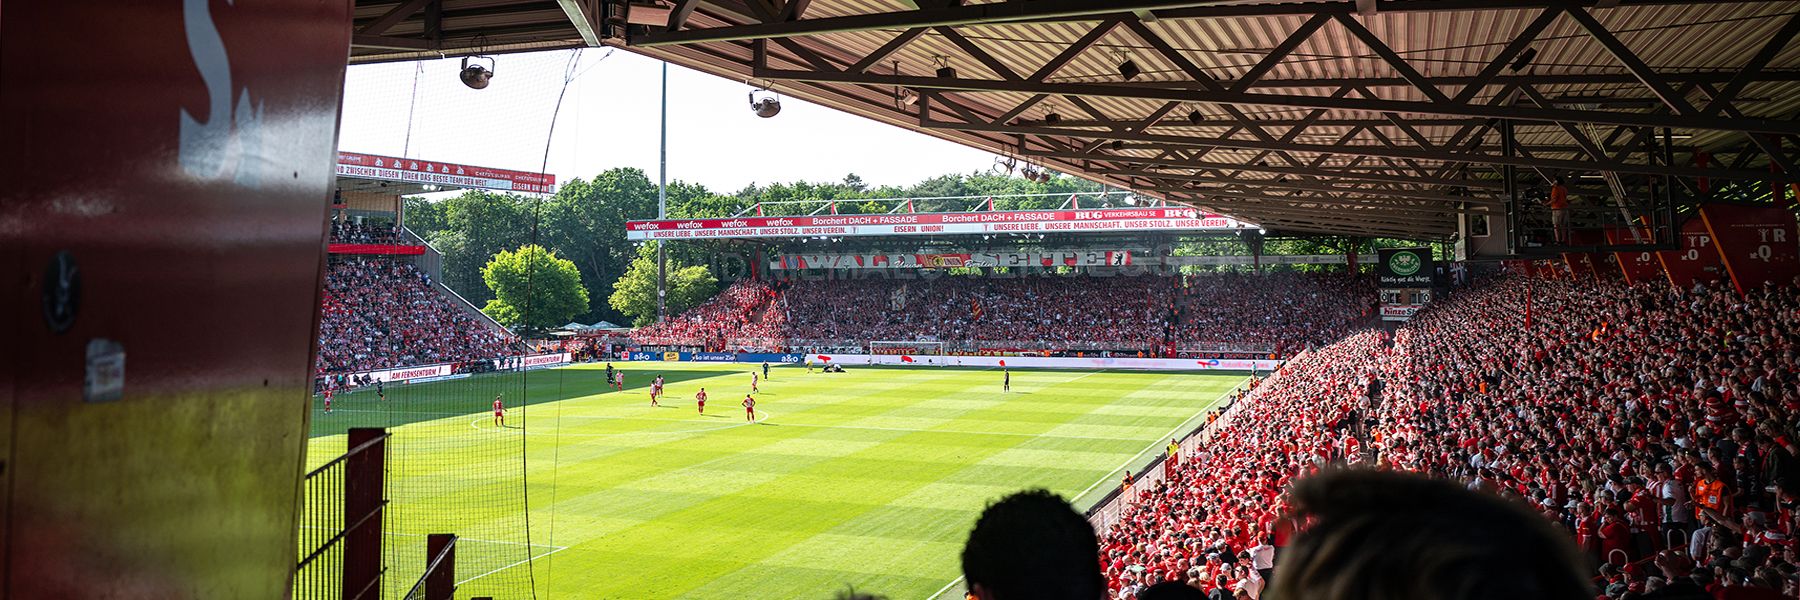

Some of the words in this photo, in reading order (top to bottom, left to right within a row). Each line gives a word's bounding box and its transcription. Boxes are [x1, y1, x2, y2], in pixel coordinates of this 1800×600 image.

[379, 169, 399, 178] DIESEN
[433, 174, 448, 183] BESTE
[450, 176, 463, 184] TEAM
[766, 218, 793, 226] wefox
[849, 216, 870, 225] DACH
[981, 213, 1004, 222] DACH
[721, 219, 748, 228] wefox
[1700, 236, 1710, 247] P
[1758, 245, 1772, 262] Q
[782, 354, 798, 362] a&o
[401, 368, 436, 379] FERNSEHTURM
